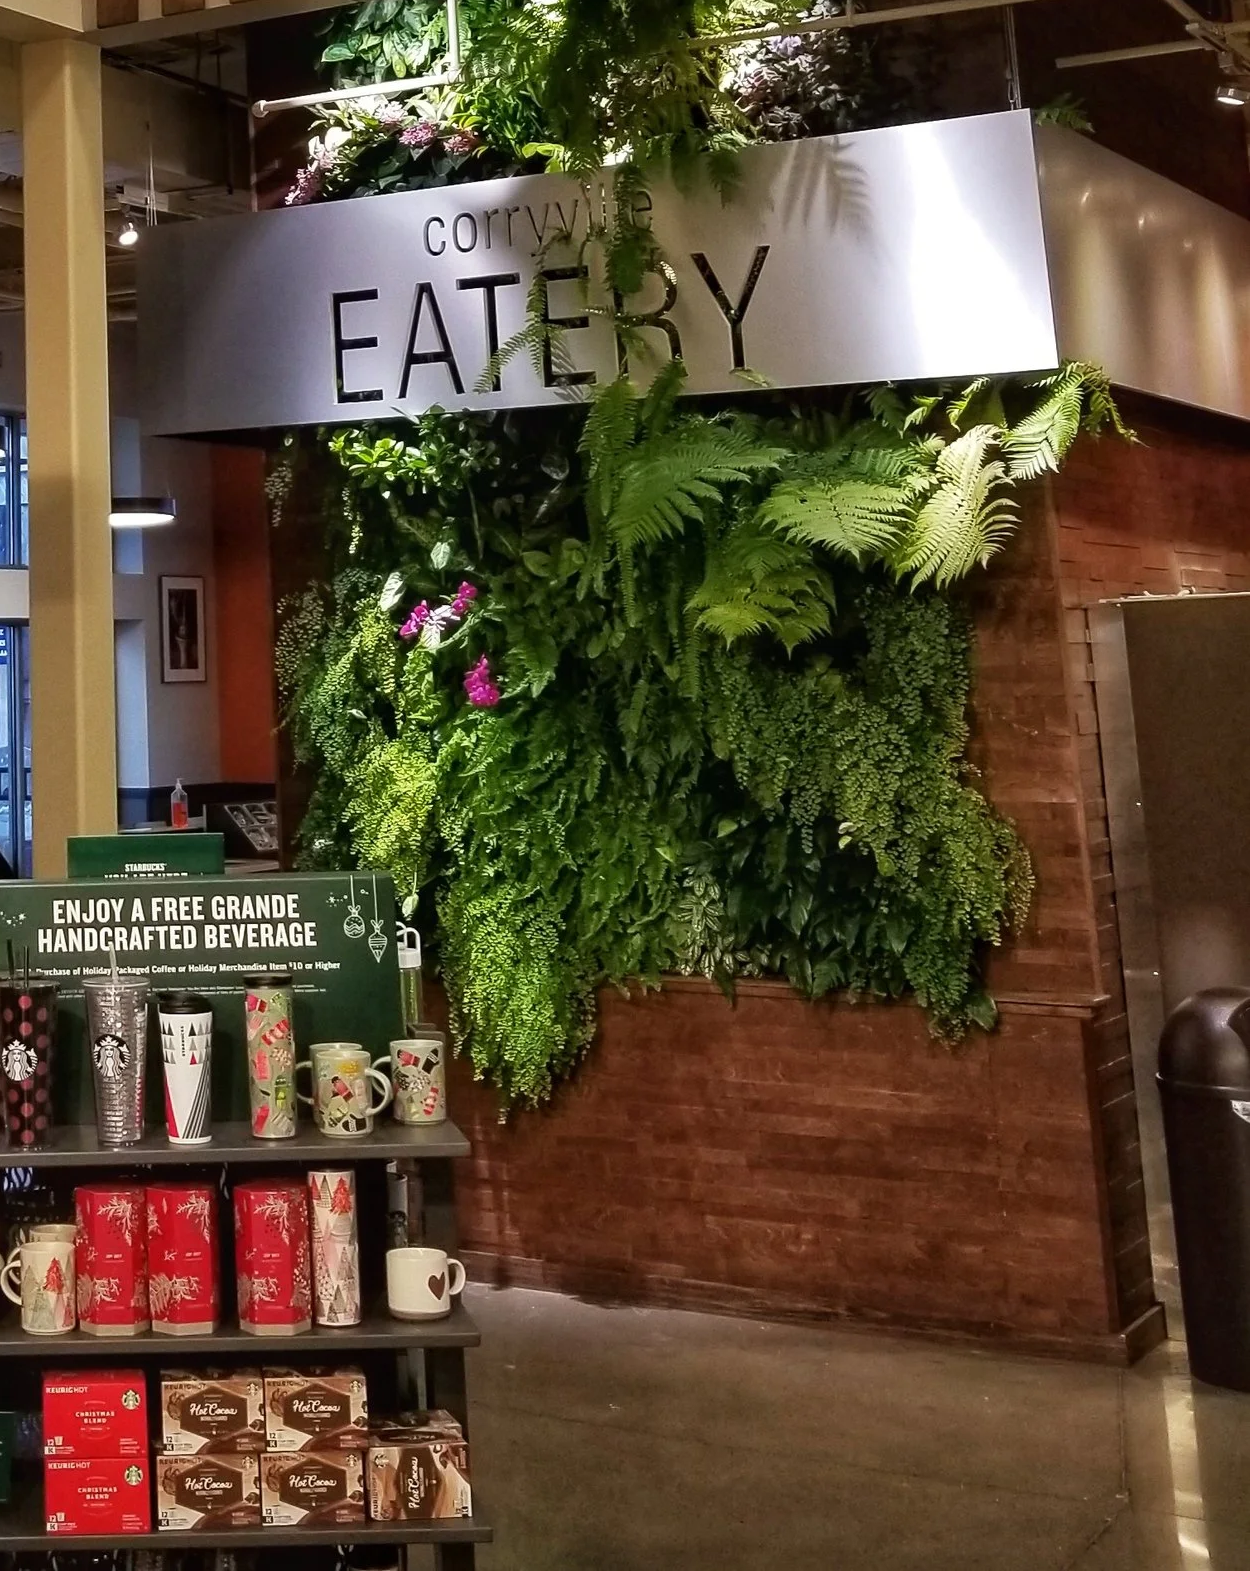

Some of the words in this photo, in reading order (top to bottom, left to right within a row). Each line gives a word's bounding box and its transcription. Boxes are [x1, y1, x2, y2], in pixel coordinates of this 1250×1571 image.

[423, 181, 653, 257] corryvile
[330, 244, 770, 405] EATERY
[124, 863, 167, 872] STARBUCKS
[52, 898, 125, 924] ENJOY
[131, 897, 146, 922] A
[151, 896, 205, 922] FREE
[211, 894, 300, 920] GRANDE
[37, 925, 197, 953] HANDCRAFTED
[204, 921, 318, 949] BEVERAGE
[72, 967, 81, 975] of
[82, 967, 112, 976] Holiday
[151, 965, 176, 974] Coffee
[178, 965, 187, 973] or
[188, 963, 217, 974] Holiday
[219, 962, 267, 972] Merchandise
[269, 962, 287, 971] Item
[289, 962, 303, 970] $10
[315, 961, 340, 971] Higher
[46, 1386, 74, 1394] KEURIG
[190, 1403, 207, 1415] Hot
[207, 1403, 237, 1415] Cocoa
[293, 1400, 310, 1412] Hot
[310, 1400, 340, 1412] Cocoa
[408, 1456, 419, 1490] Cocoa
[185, 1478, 202, 1490] Hot
[202, 1477, 232, 1490] Cocoa
[289, 1475, 307, 1487] Hot
[307, 1475, 337, 1487] Cocoa
[408, 1489, 420, 1508] Hot
